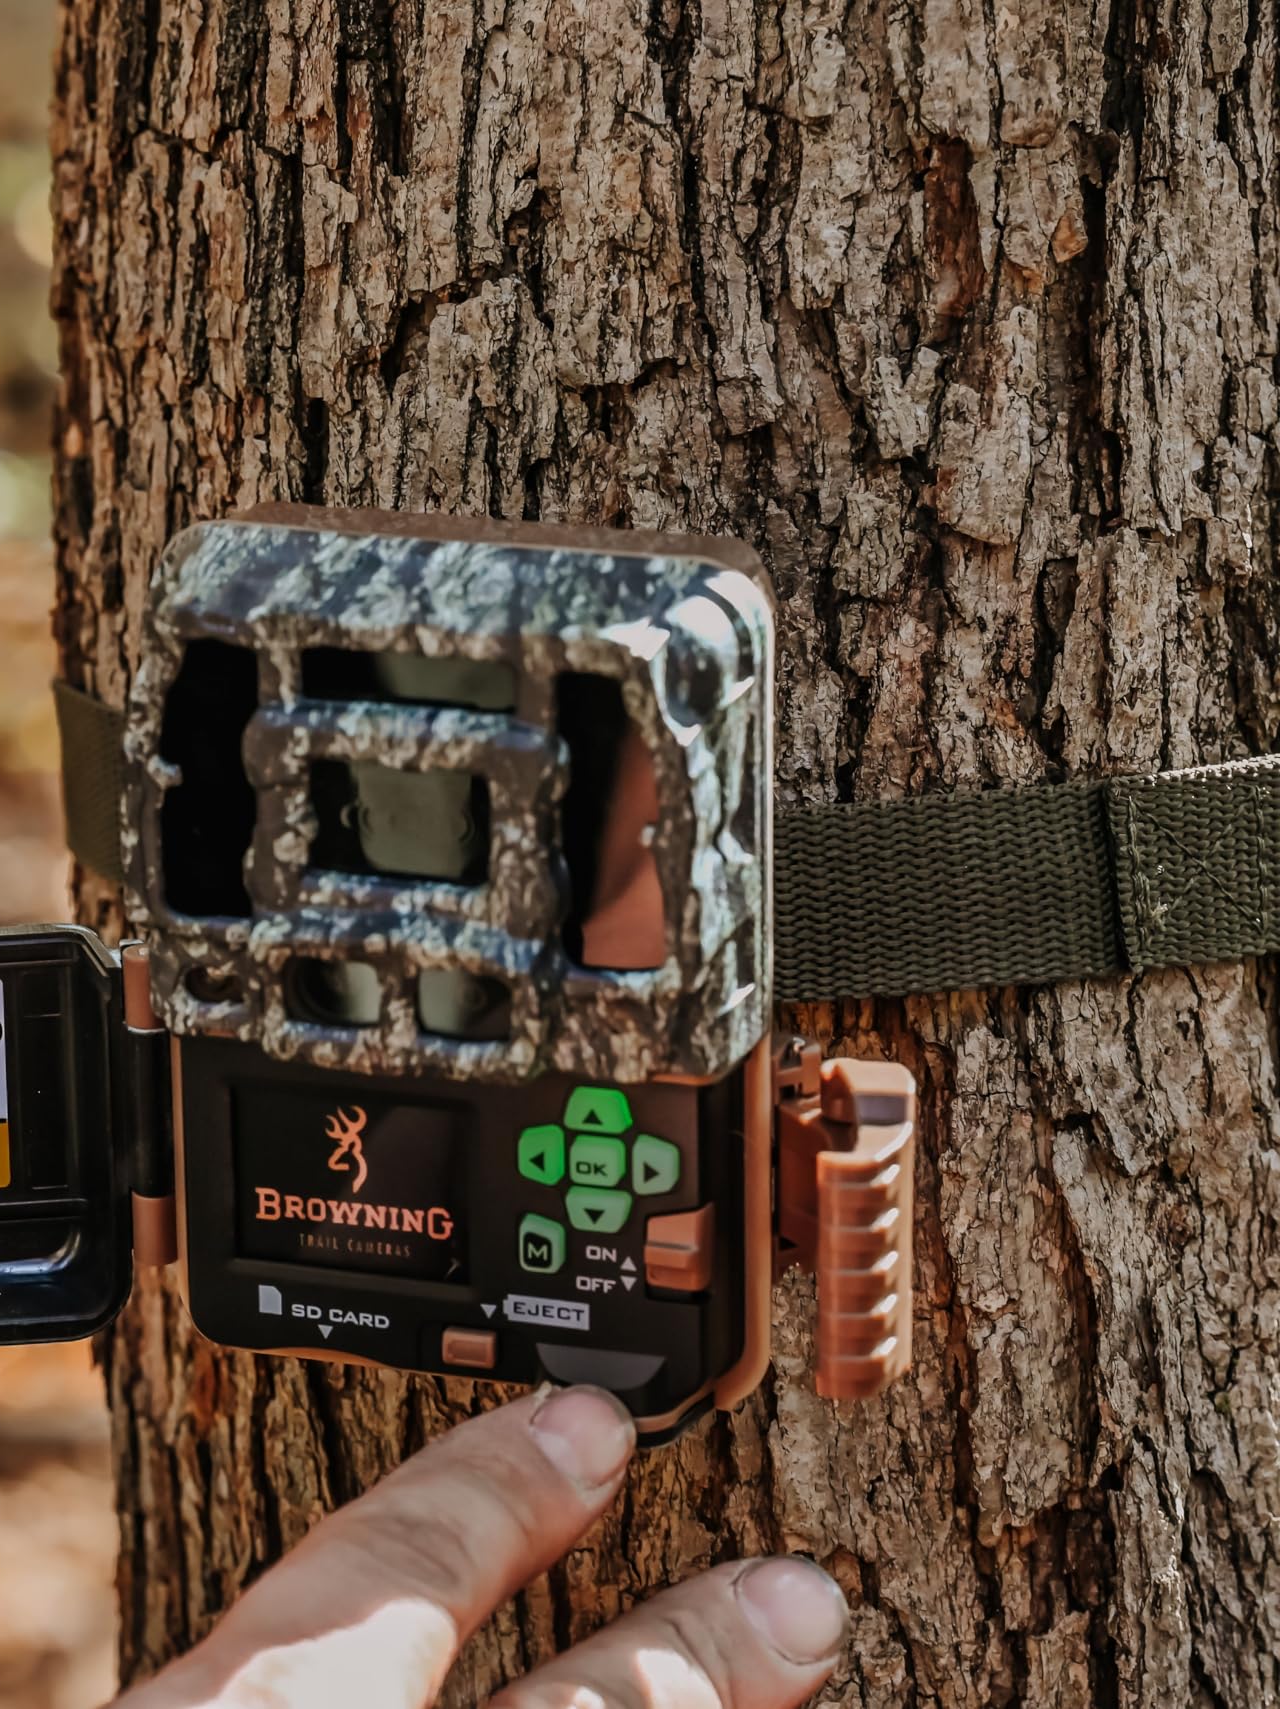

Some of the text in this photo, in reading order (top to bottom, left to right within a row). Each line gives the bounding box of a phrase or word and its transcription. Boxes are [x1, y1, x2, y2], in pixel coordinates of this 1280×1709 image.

[576, 1160, 608, 1178] OK
[254, 1187, 454, 1240] BROWNING
[299, 1232, 411, 1258] TRAIL CAMERAS
[527, 1240, 549, 1261] M
[585, 1245, 618, 1262] ON
[576, 1276, 617, 1294] OFF
[290, 1303, 390, 1329] SD CARD
[512, 1301, 585, 1323] EJECT
